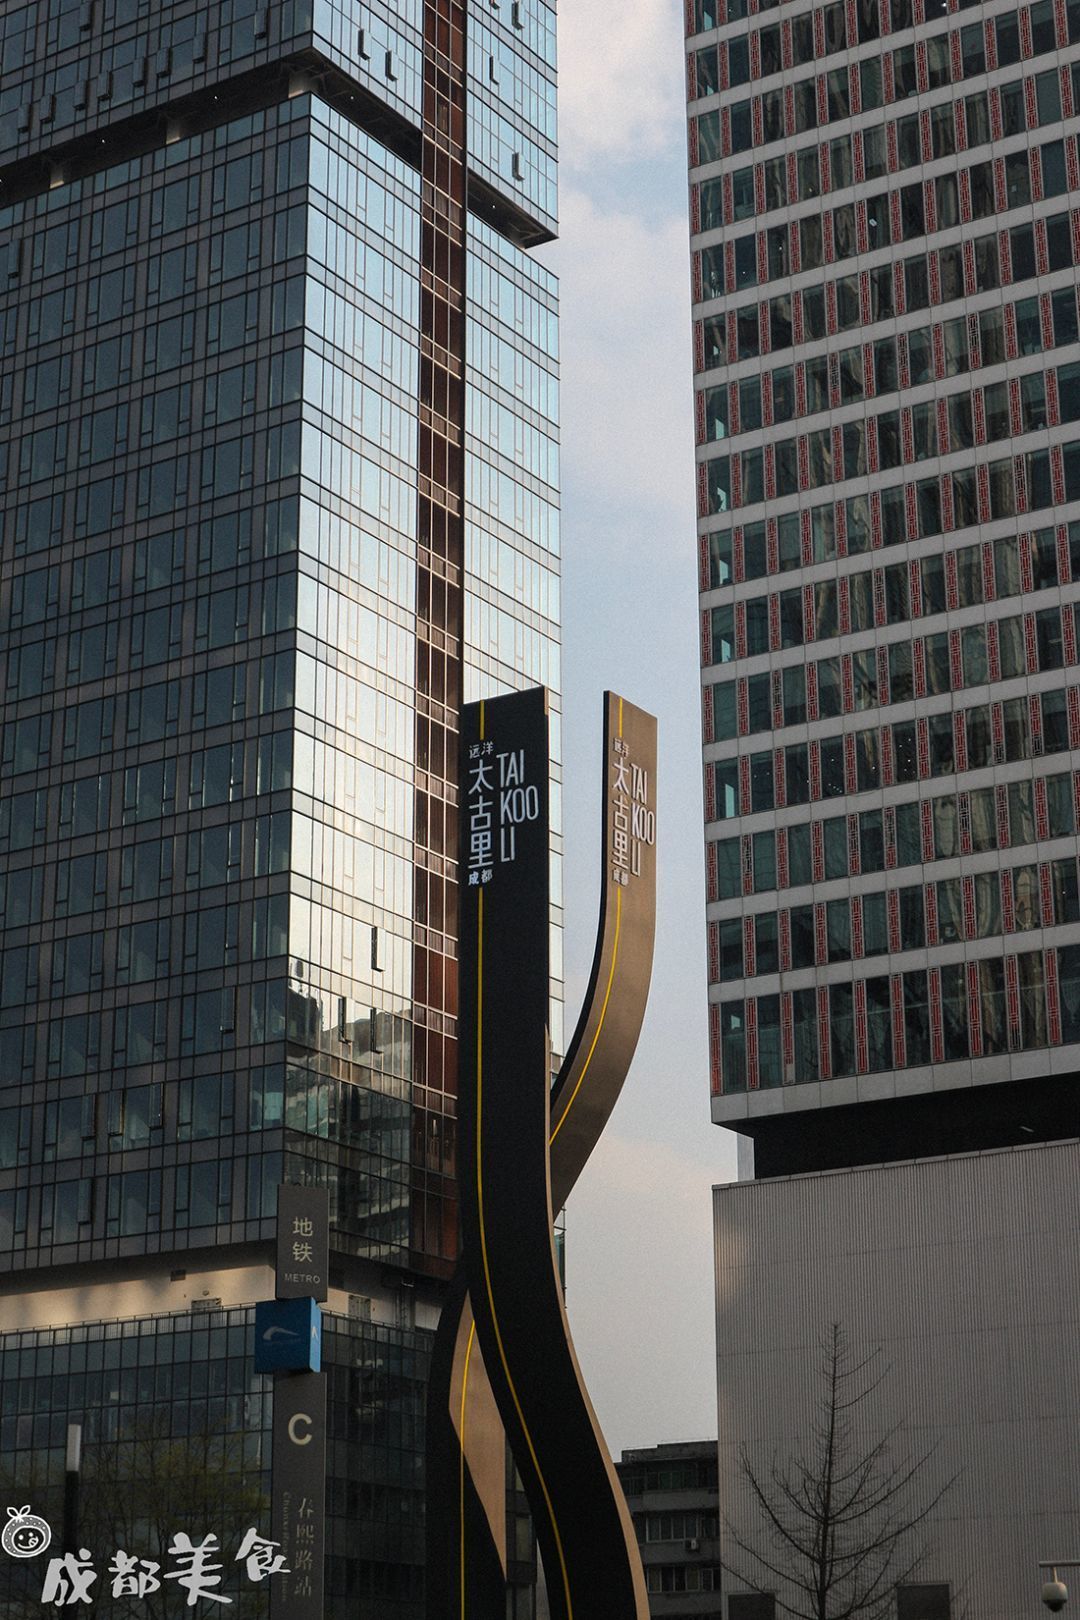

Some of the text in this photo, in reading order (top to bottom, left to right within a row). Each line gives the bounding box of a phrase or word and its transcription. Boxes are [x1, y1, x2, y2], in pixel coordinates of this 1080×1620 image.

[468, 741, 493, 759] 远洋
[496, 749, 525, 788] TAI
[629, 762, 648, 805] TAI
[468, 759, 494, 869] 太古里
[500, 785, 539, 825] KOO
[612, 757, 630, 870] 太古里
[631, 803, 655, 846] KOO
[500, 826, 515, 863] LI
[631, 839, 641, 877] LI
[468, 869, 493, 886] 成都
[292, 1216, 314, 1263] 地铁
[284, 1273, 321, 1284] METRO
[288, 1413, 313, 1446] C
